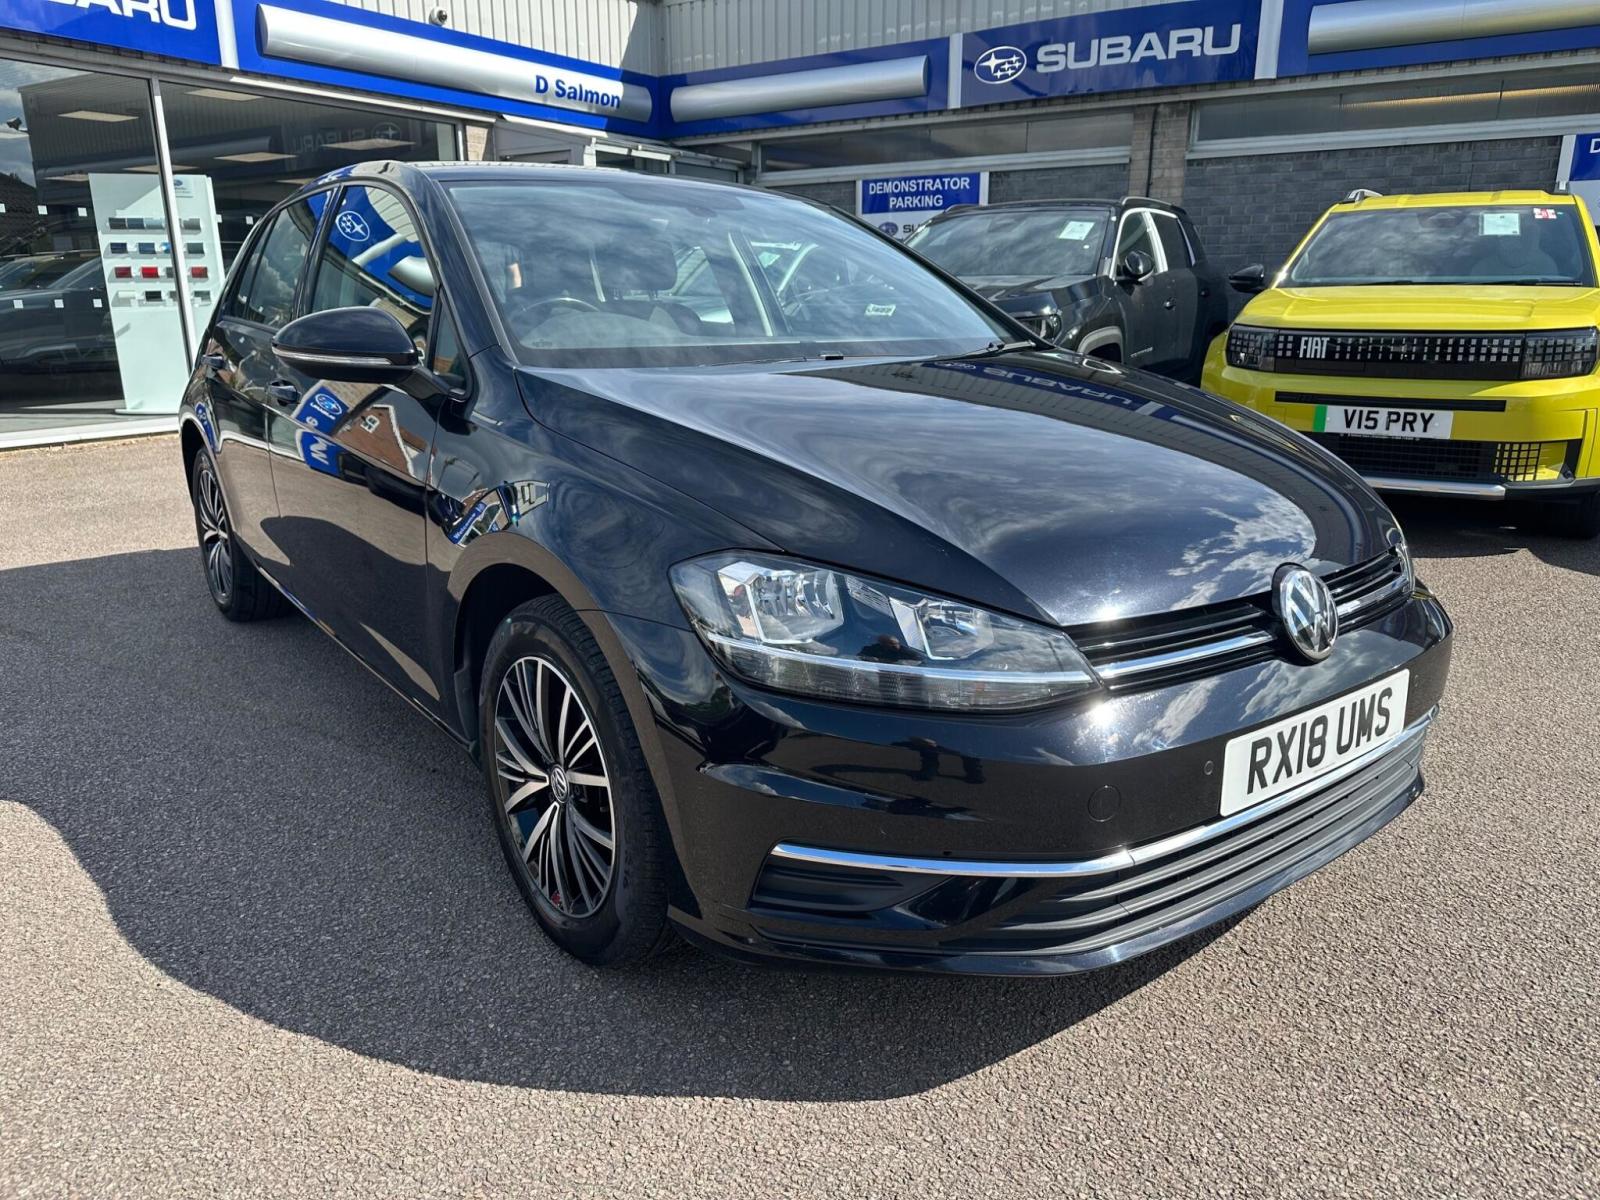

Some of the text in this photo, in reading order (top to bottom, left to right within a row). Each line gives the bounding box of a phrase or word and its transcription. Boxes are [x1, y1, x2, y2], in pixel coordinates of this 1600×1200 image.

[1036, 23, 1242, 74] SUBARU
[535, 74, 621, 109] D Salmon
[868, 176, 971, 196] DEMONSTRATOR
[889, 194, 944, 209] PARKING
[1299, 336, 1330, 359] FIAT
[1343, 408, 1435, 433] V15 PRY
[1246, 686, 1393, 795] RX18 UMS
